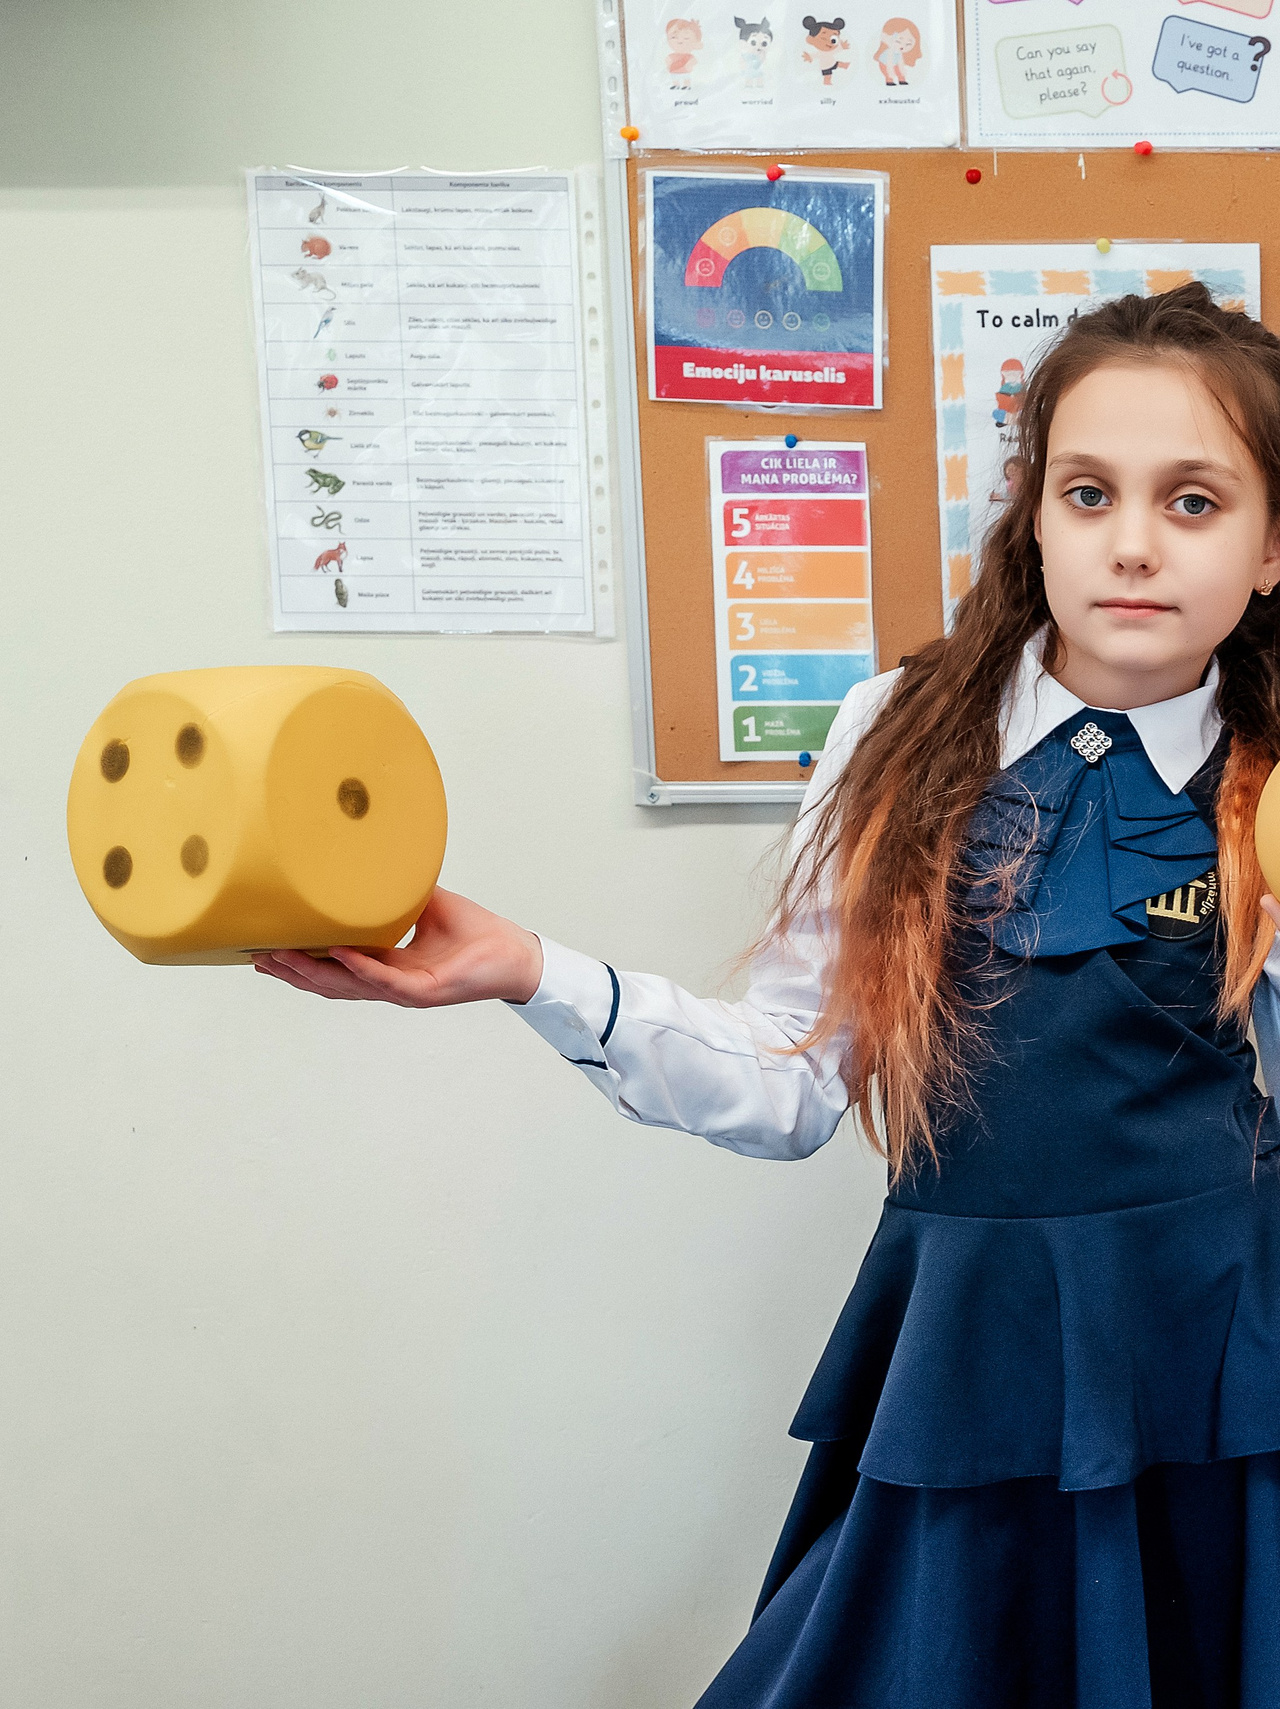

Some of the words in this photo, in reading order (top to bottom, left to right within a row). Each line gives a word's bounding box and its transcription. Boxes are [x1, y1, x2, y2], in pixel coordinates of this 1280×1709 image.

[1016, 46, 1042, 61] Can
[1048, 44, 1071, 58] you
[1076, 40, 1098, 56] say
[1180, 34, 1203, 52] I've
[1207, 42, 1228, 59] got
[1231, 51, 1240, 62] a
[1025, 66, 1052, 82] that
[1177, 60, 1233, 83] question.
[742, 98, 773, 106] worried
[1039, 82, 1088, 104] please?
[976, 309, 1003, 328] To
[1011, 307, 1059, 328] calm
[682, 362, 757, 384] Emociju
[759, 365, 846, 384] karuselis
[760, 458, 783, 470] CIK
[786, 458, 821, 470] LIELA
[823, 458, 837, 470] IR
[740, 473, 779, 485] MANA
[782, 471, 858, 485] PROBLĒMA?
[731, 507, 752, 538] 5
[732, 560, 755, 590] 4
[735, 612, 756, 642] 3
[738, 664, 759, 692] 2
[742, 716, 762, 743] 1
[1199, 871, 1219, 916] mnāzija
